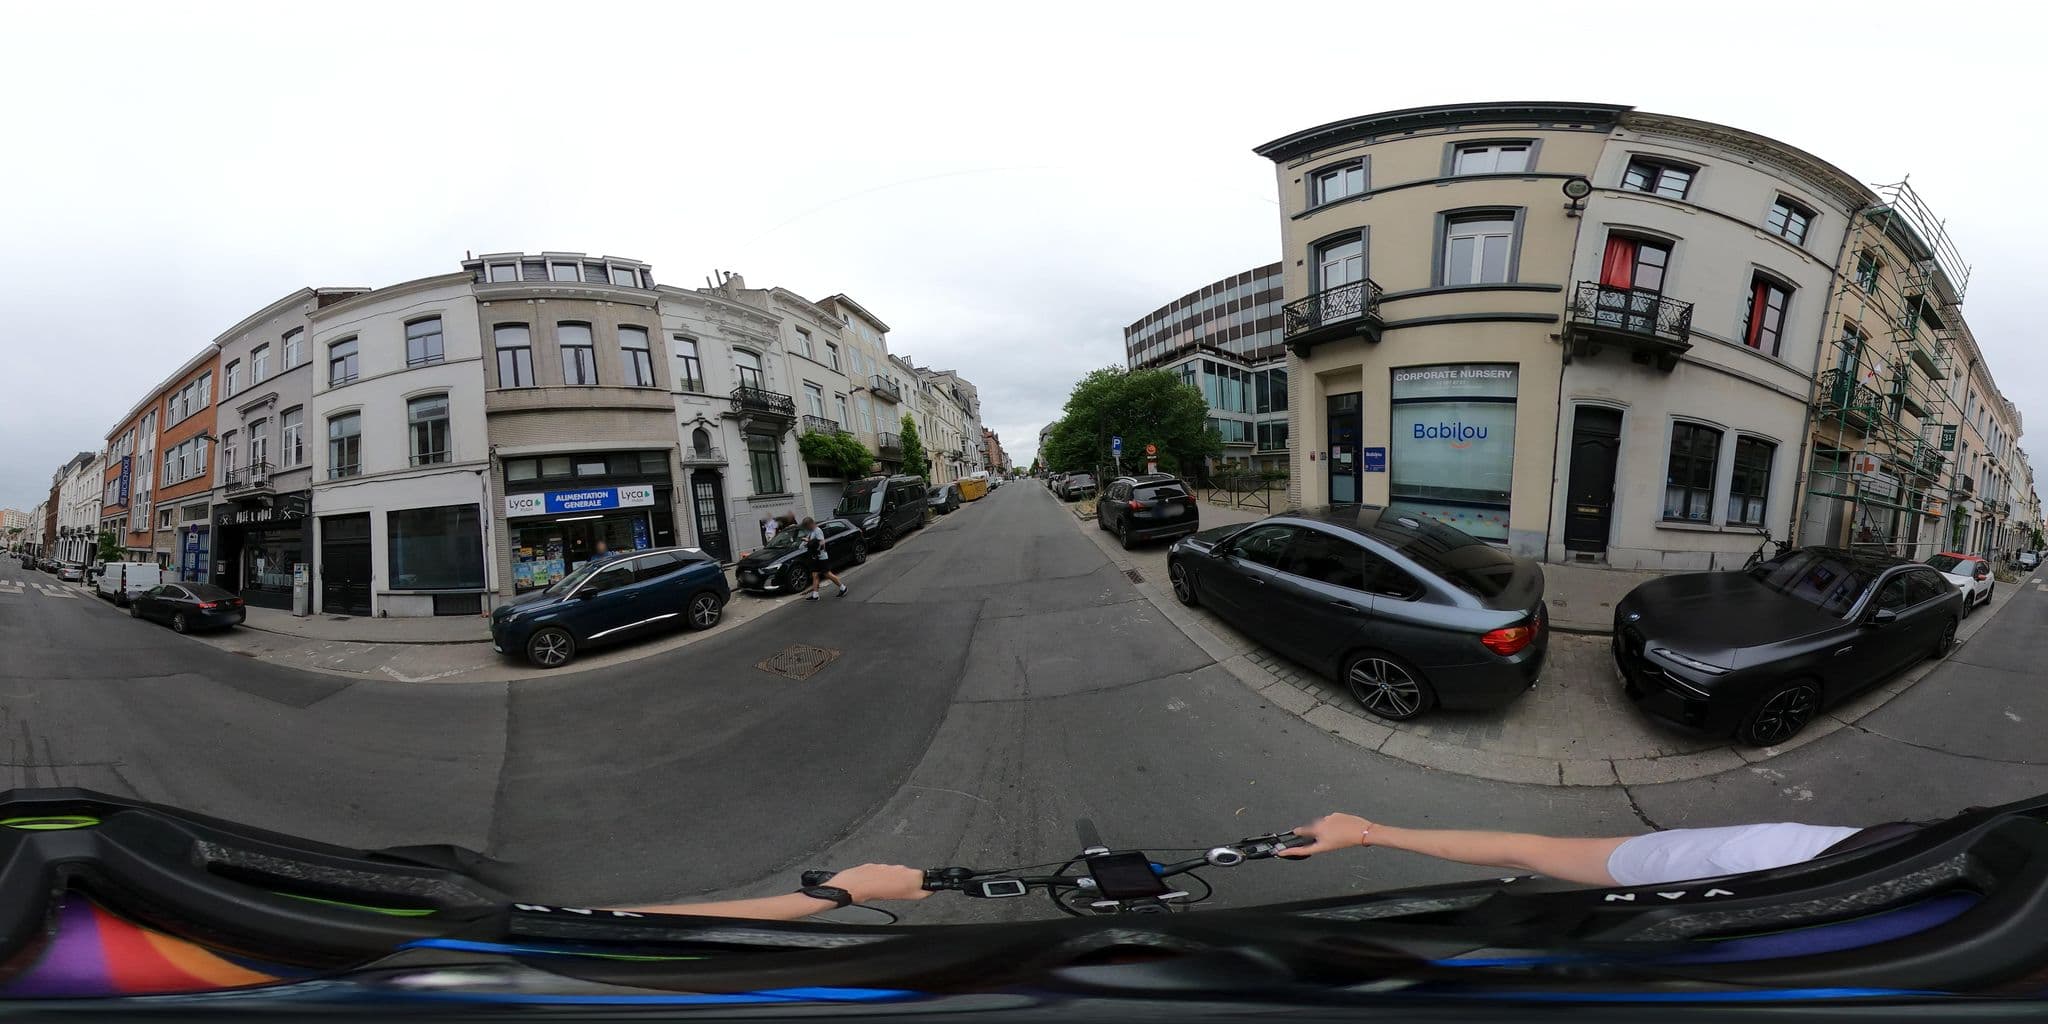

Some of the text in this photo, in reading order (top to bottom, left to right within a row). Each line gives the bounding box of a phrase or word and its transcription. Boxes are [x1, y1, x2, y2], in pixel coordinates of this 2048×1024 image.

[1396, 370, 1513, 381] CORPORATE NURSERY
[1414, 422, 1488, 442] Babilou
[1113, 439, 1121, 448] P
[555, 491, 608, 502] ALIMENTATION
[621, 489, 643, 501] Lyca
[509, 498, 533, 509] Lyca
[564, 499, 602, 509] GENERALE
